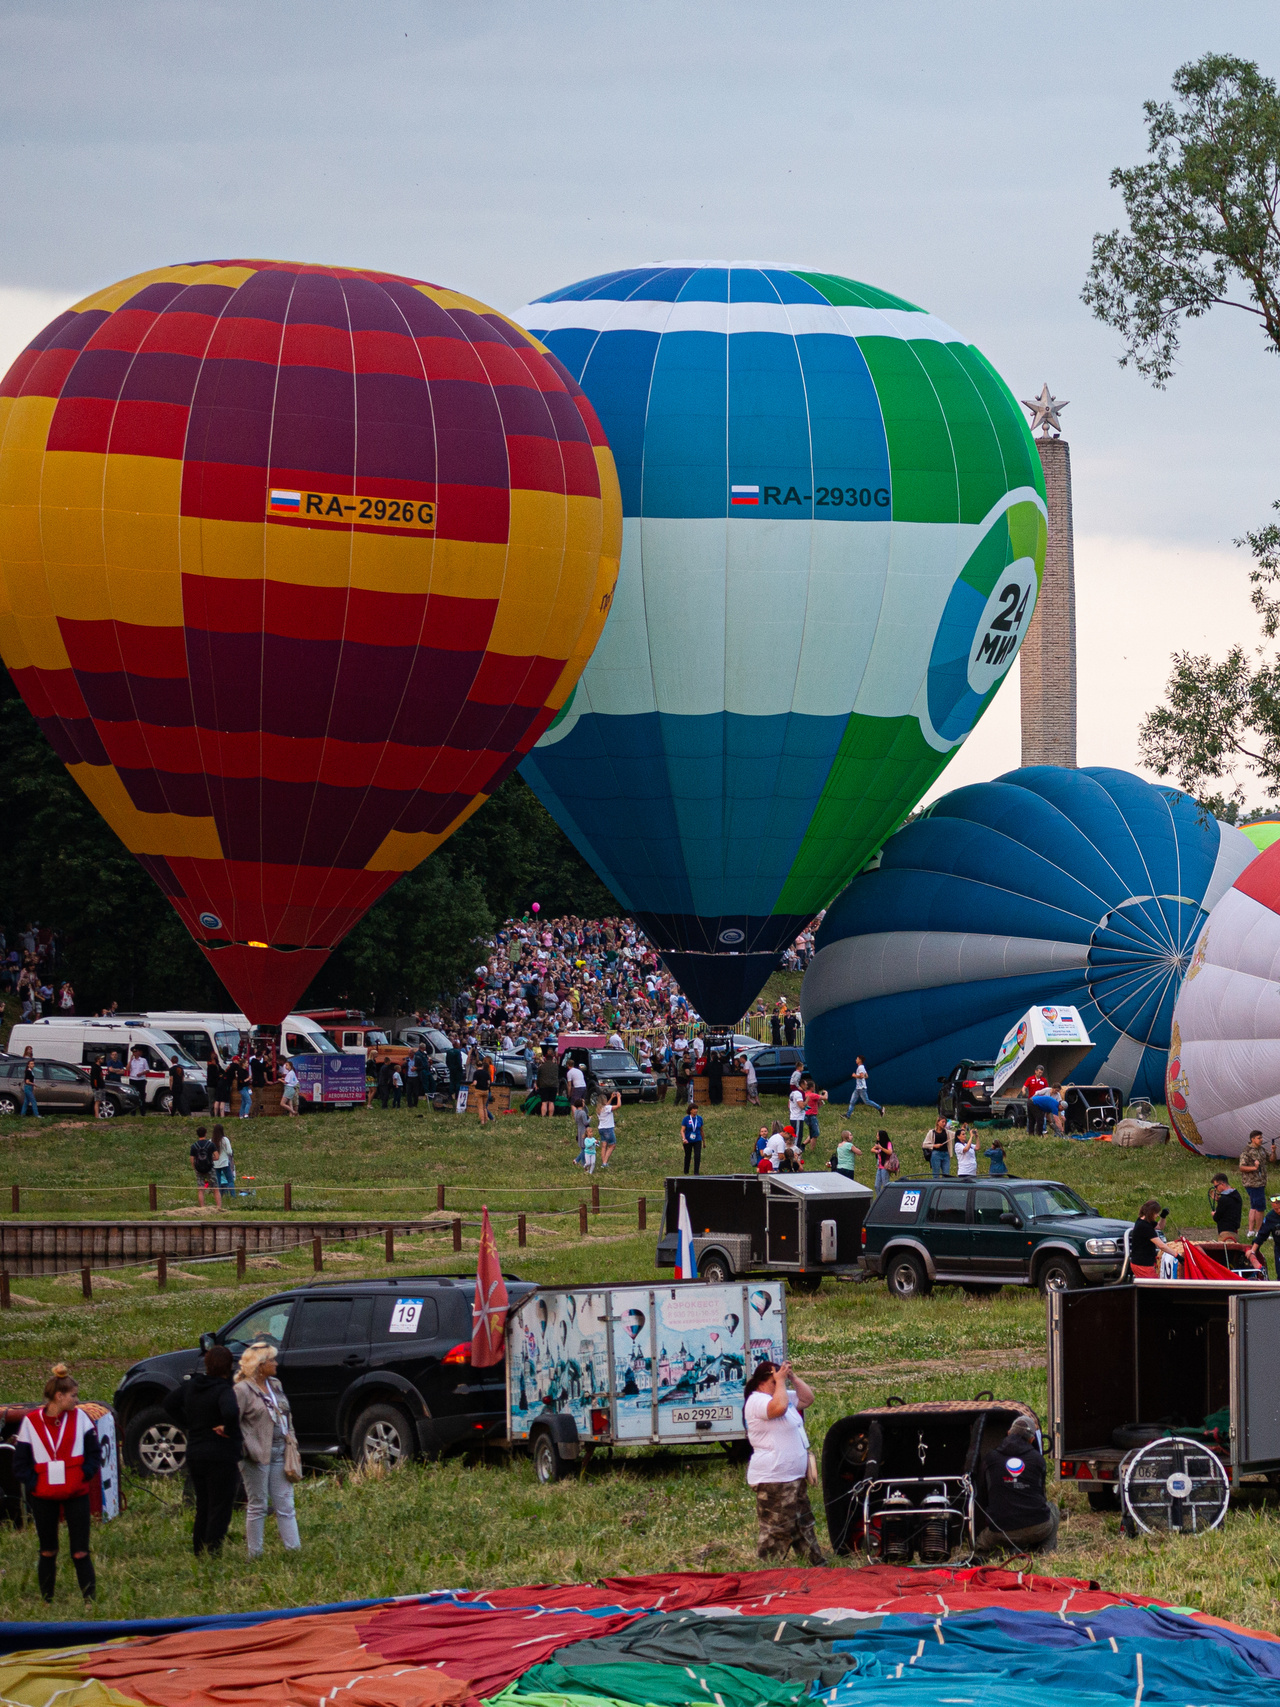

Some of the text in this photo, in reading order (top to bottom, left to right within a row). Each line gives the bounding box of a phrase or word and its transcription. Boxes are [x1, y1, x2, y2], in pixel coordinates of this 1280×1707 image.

[763, 486, 890, 507] RA-2930G
[306, 493, 434, 524] RA-2926G
[990, 583, 1031, 632] 24
[975, 632, 1017, 666] МИР
[903, 1195, 917, 1206] 29
[397, 1305, 416, 1323] 19
[677, 1407, 729, 1421] АО 2992 71
